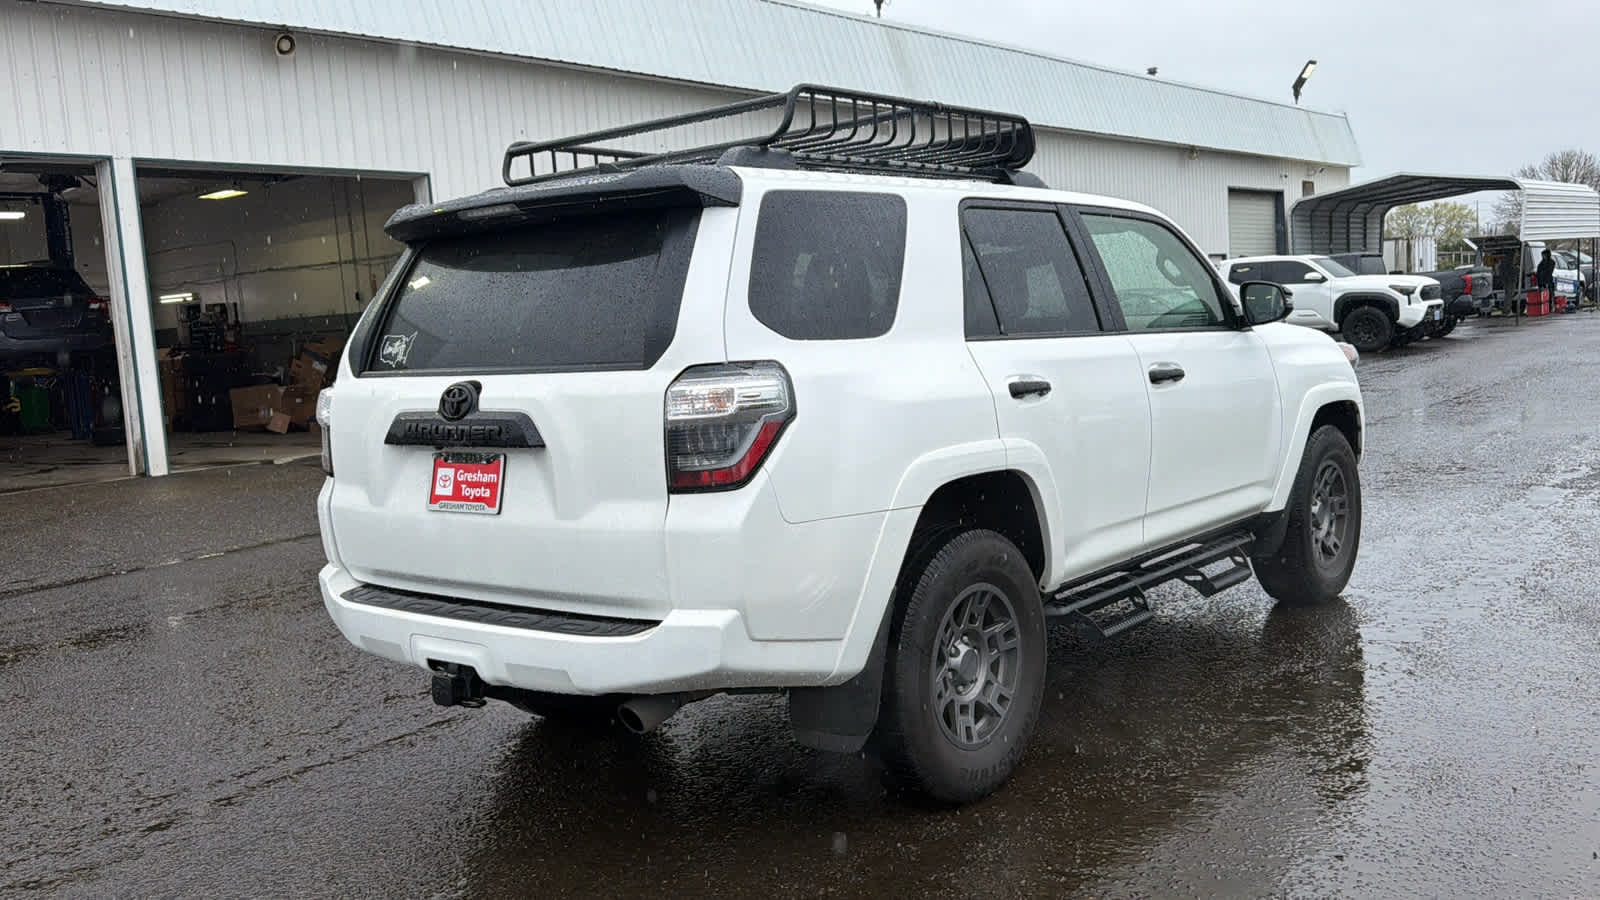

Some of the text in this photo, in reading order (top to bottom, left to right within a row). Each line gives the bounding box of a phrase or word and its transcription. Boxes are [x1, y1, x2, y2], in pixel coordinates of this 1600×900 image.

[457, 469, 497, 483] Gresham
[461, 484, 490, 499] Toyota
[439, 502, 486, 511] GRESHAM TOYOTA
